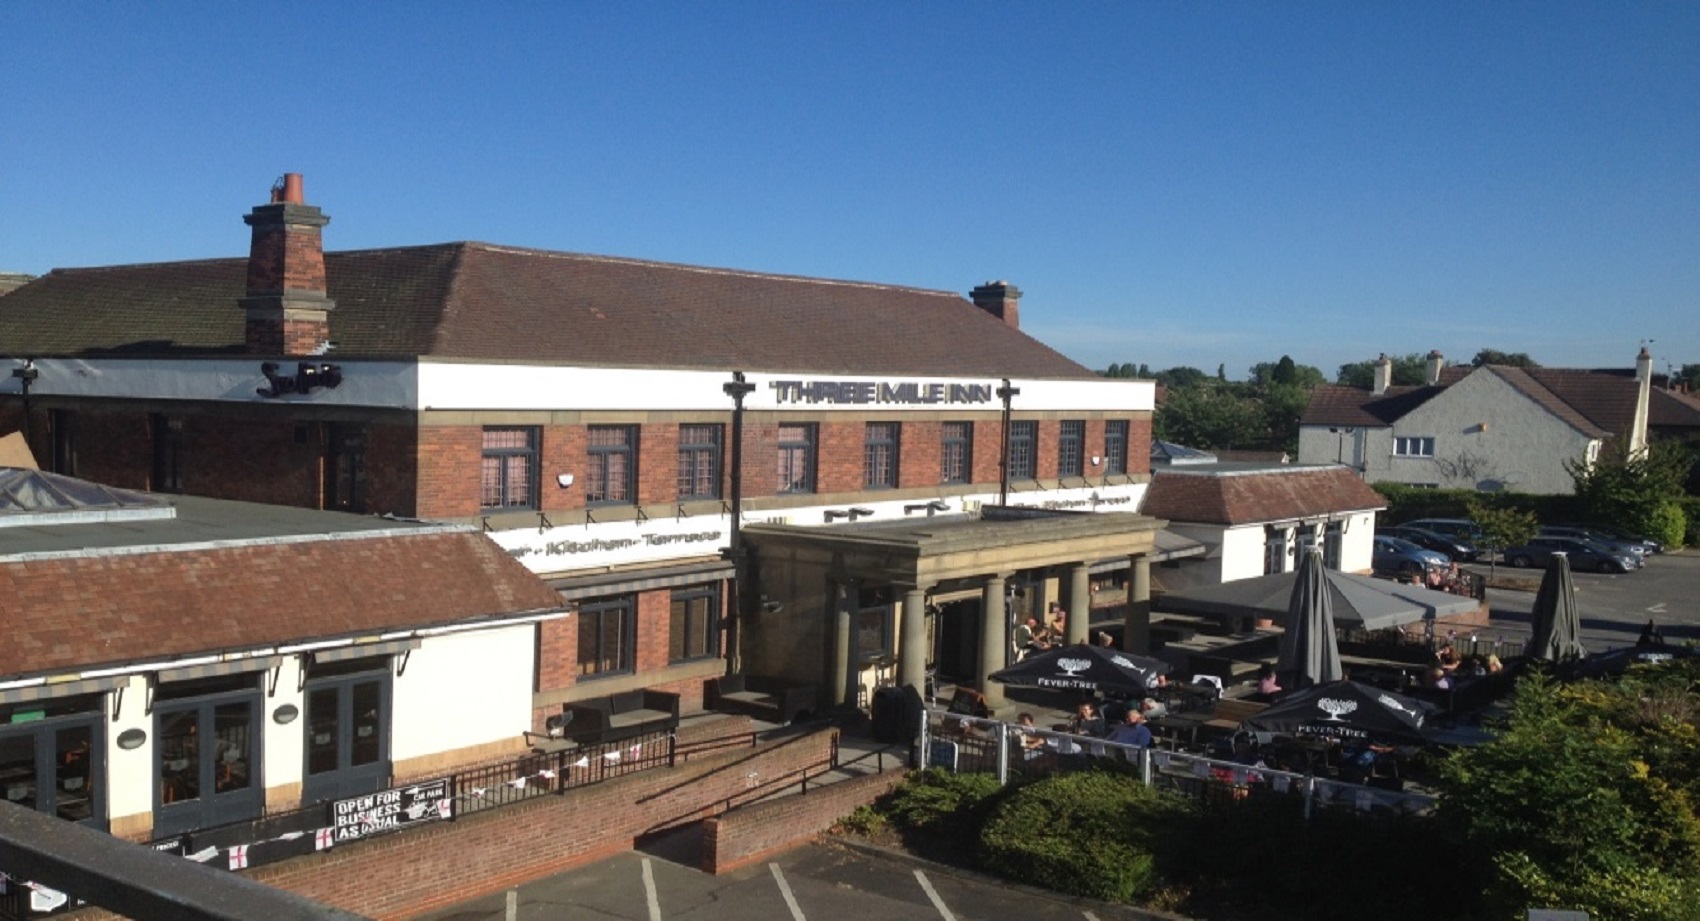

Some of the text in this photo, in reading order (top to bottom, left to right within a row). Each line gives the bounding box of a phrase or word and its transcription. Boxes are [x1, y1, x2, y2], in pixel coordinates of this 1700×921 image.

[769, 380, 992, 404] THREE MILE INN
[338, 791, 401, 815] OPEN FOR
[413, 788, 443, 801] CAR PARK
[337, 803, 402, 827] BUSINESS
[339, 815, 400, 839] AS USUAL
